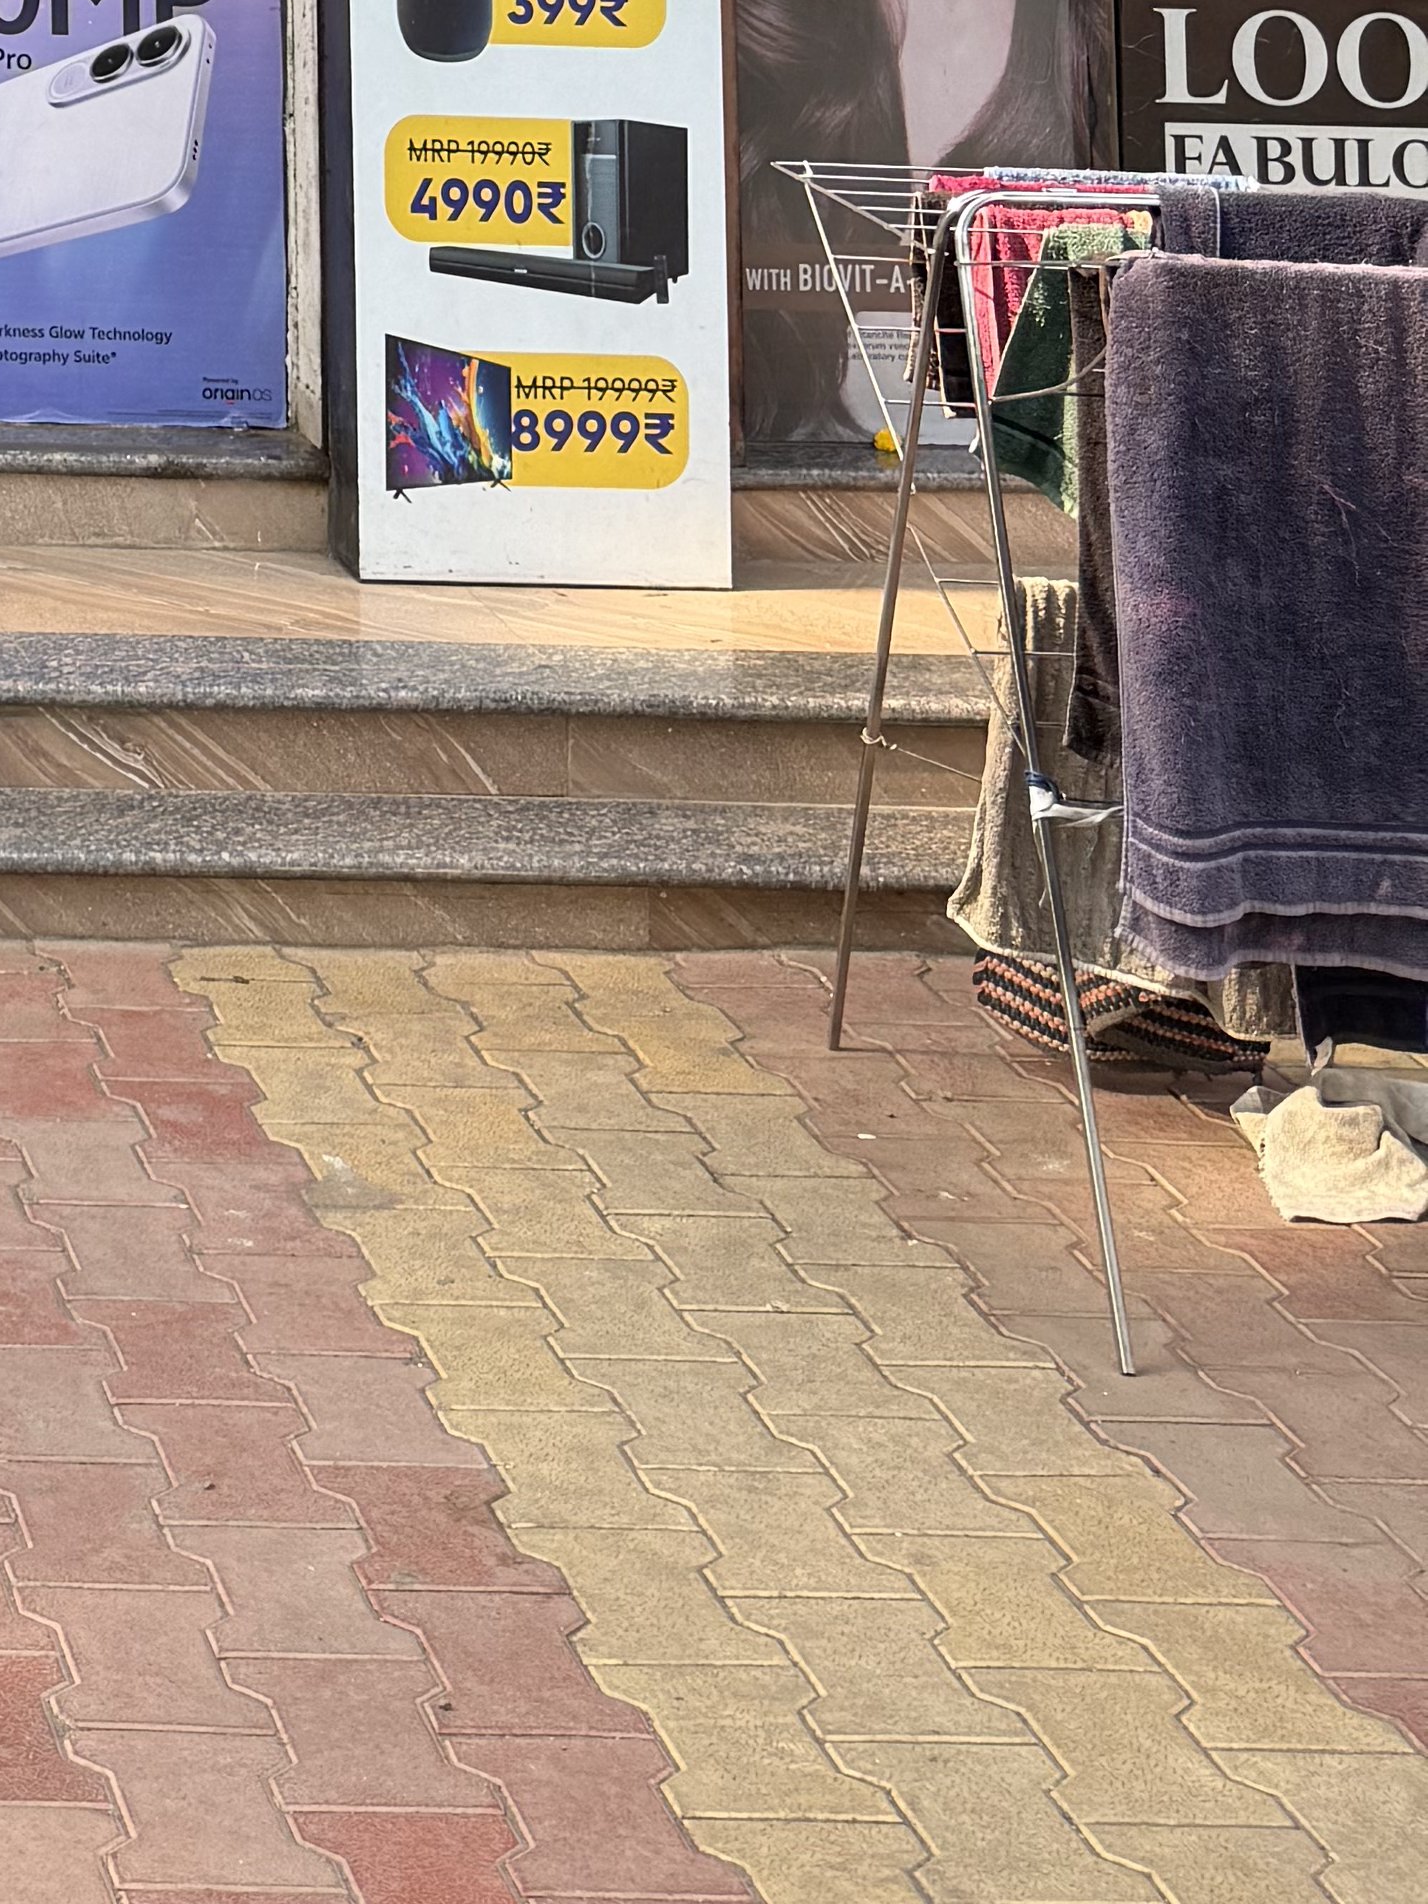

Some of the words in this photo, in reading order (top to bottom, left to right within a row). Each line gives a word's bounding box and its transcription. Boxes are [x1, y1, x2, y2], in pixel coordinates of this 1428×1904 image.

[1153, 8, 1428, 109] LOO
[410, 178, 566, 226] 4990₹
[746, 267, 791, 291] WITH
[49, 325, 85, 341] Glow
[89, 326, 173, 345] Technology
[515, 375, 573, 401] MRP
[582, 376, 677, 402] 19999₹
[511, 409, 675, 455] 8999₹
